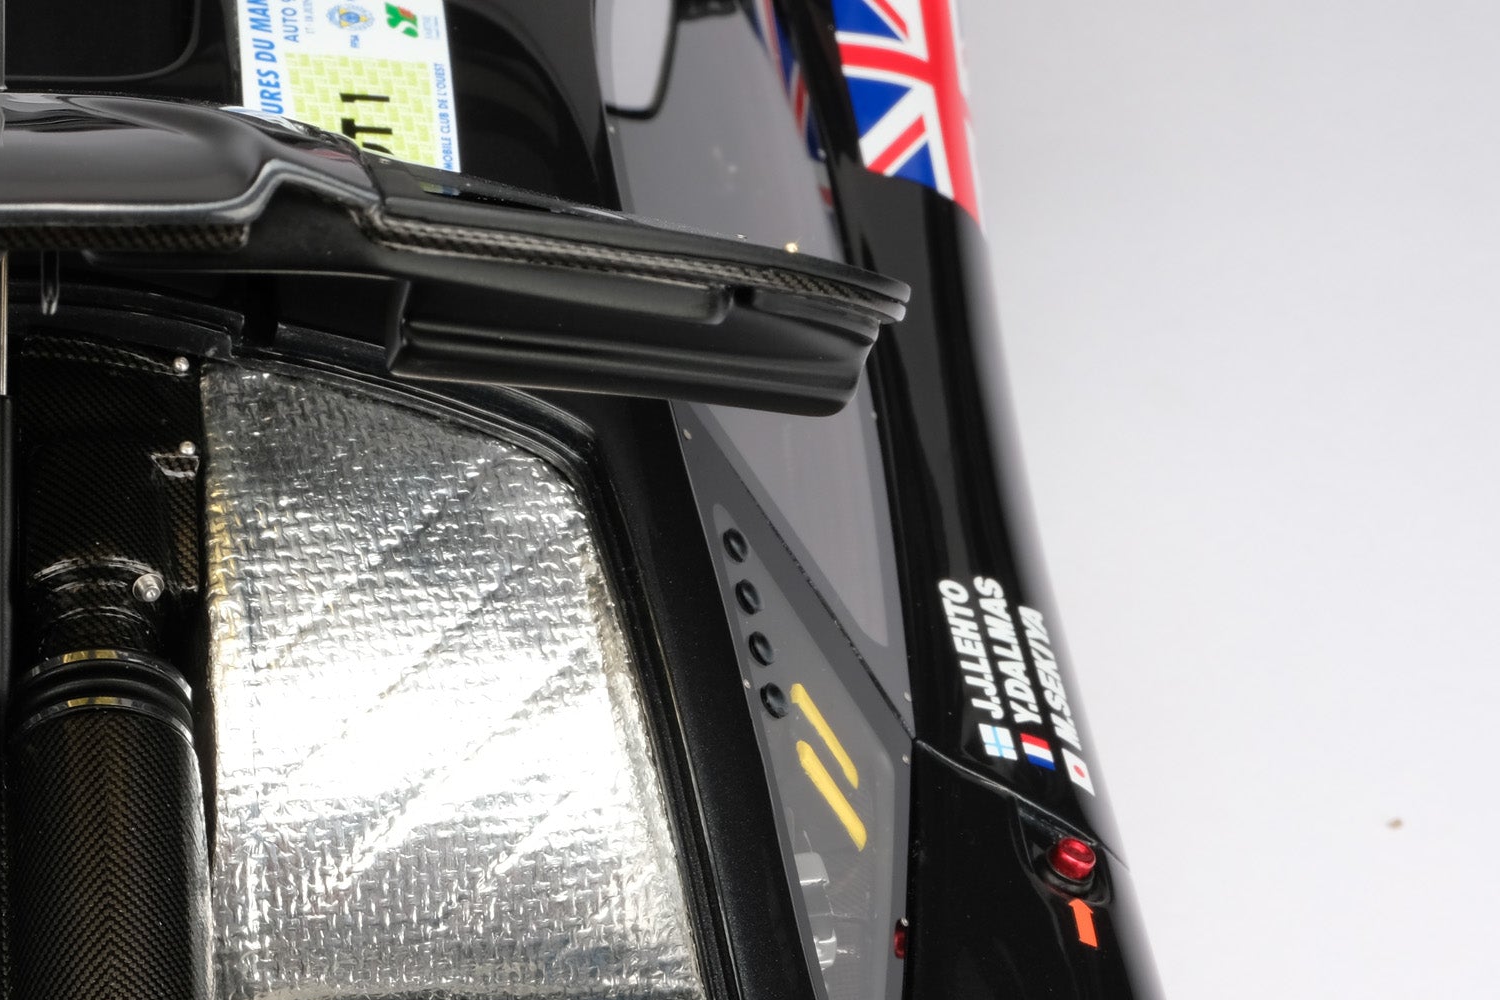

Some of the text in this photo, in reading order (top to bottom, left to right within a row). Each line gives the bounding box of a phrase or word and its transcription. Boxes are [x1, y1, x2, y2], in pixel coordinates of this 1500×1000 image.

[281, 7, 300, 43] AUTO
[252, 38, 278, 63] DU
[437, 98, 449, 110] DE
[438, 112, 450, 134] CLUB
[938, 579, 1004, 720] J.J.LEHTO
[973, 576, 1043, 724] Y.DALMAS
[1018, 605, 1082, 751] M.SEKIYA
